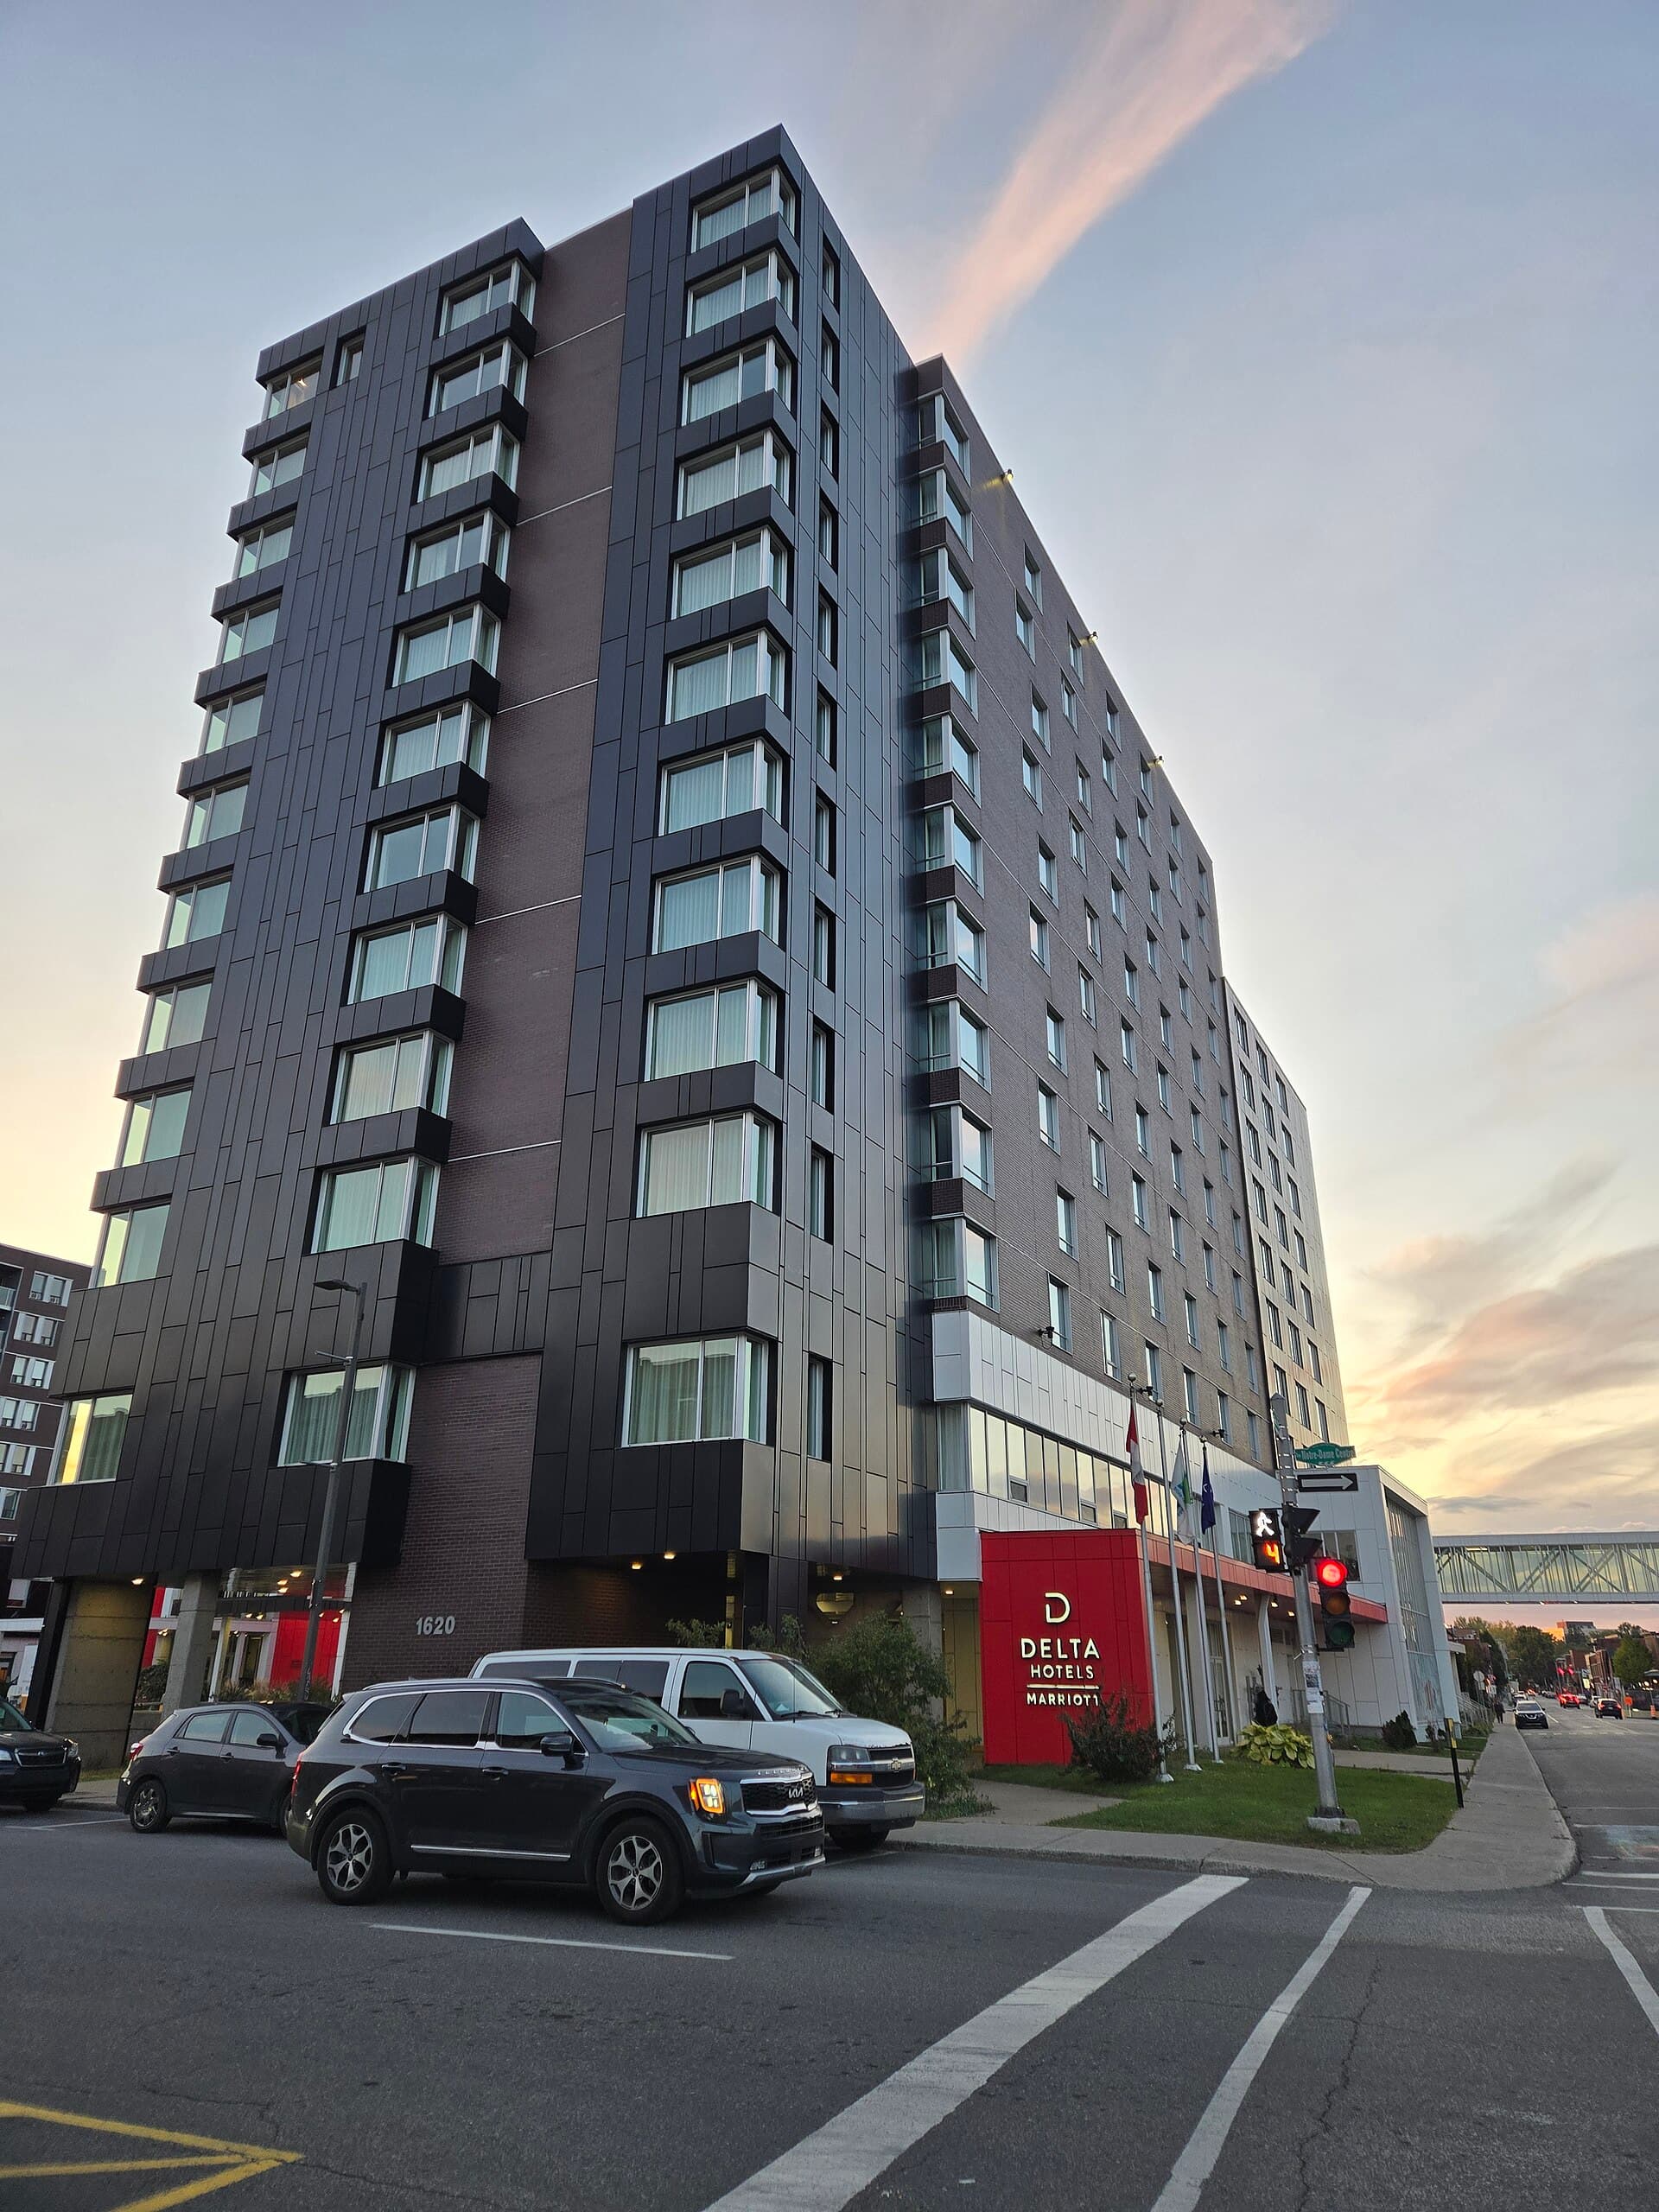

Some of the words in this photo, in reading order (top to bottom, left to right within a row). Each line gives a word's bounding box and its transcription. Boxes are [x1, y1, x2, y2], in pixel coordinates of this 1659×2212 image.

[1301, 1449, 1335, 1460] Notre-Dame
[1265, 1541, 1280, 1564] 4
[1045, 1592, 1071, 1623] D
[416, 1616, 455, 1635] 1620
[1020, 1637, 1100, 1659] DELTA
[1030, 1664, 1094, 1679] HOTELS
